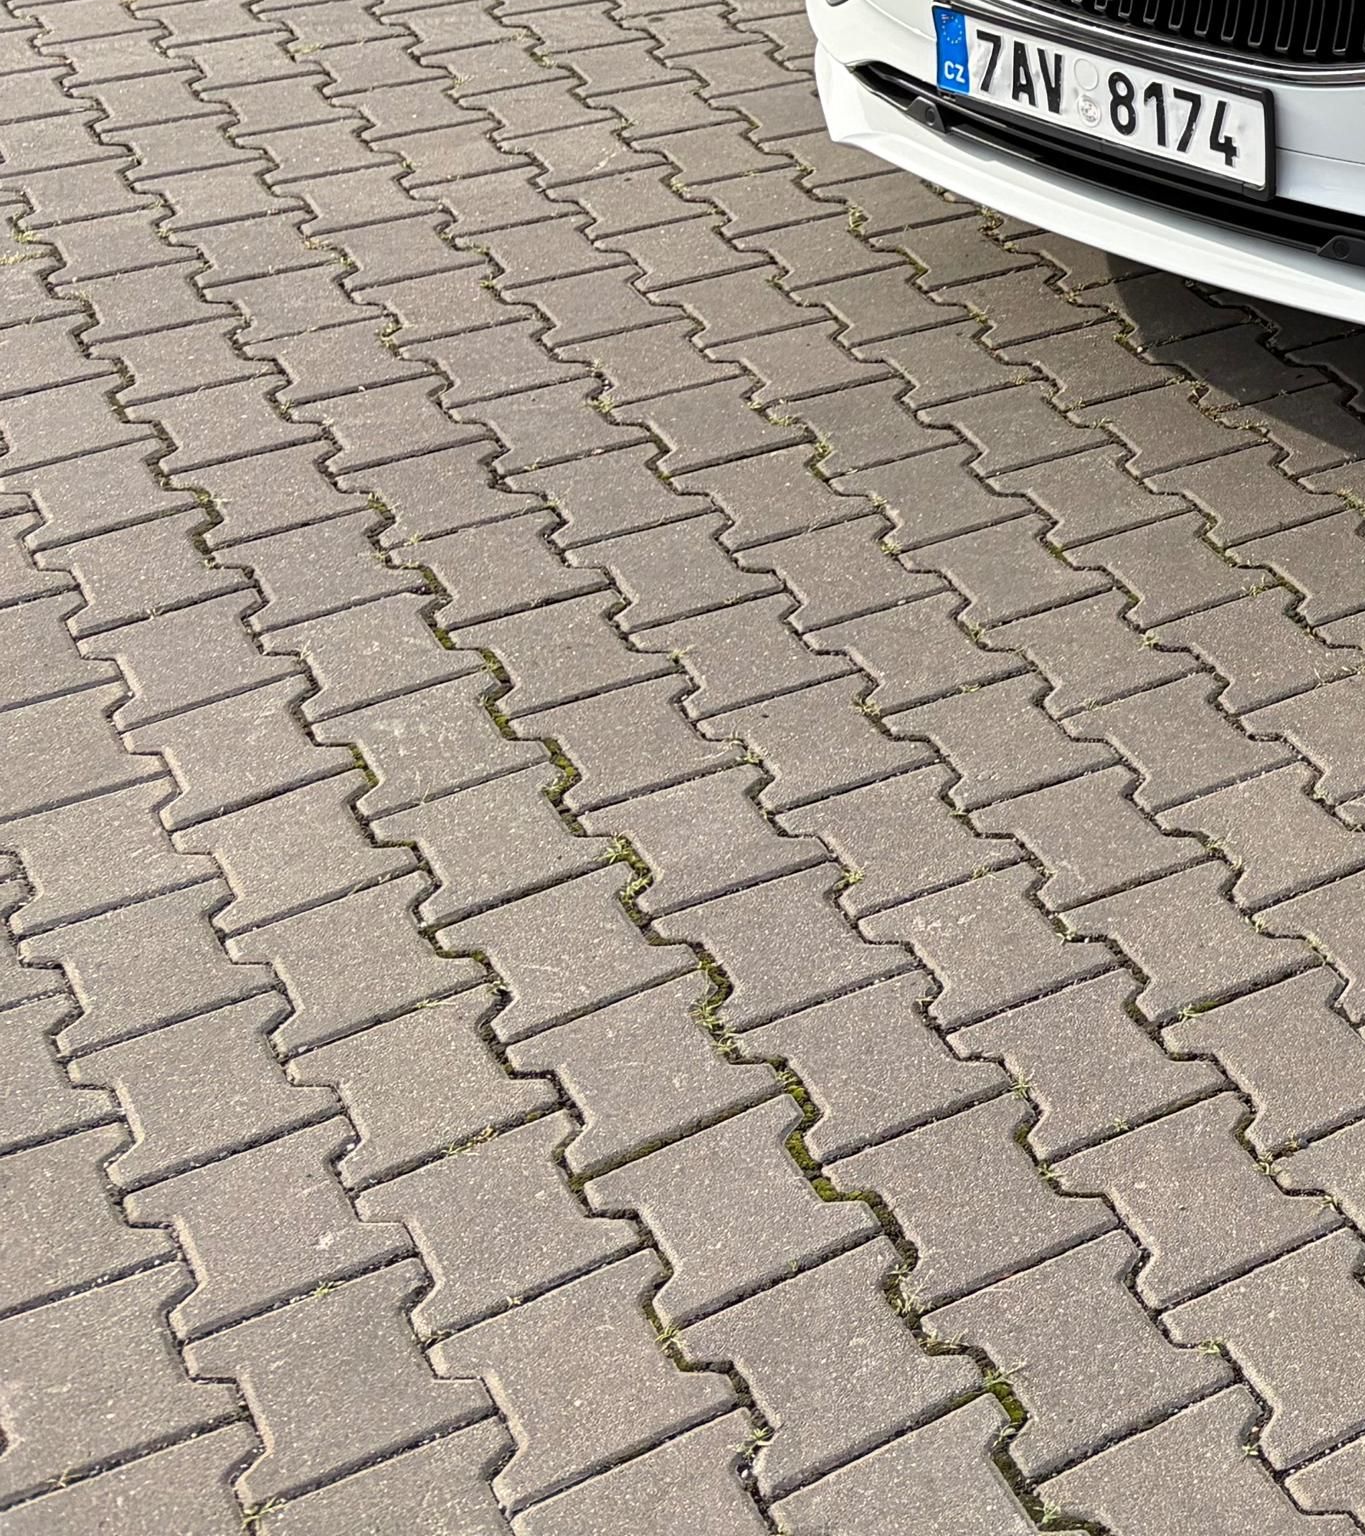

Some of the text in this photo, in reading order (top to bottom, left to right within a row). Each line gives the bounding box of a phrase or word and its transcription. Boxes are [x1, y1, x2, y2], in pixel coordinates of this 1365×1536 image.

[943, 29, 1239, 168] CZ 7AV 8174
